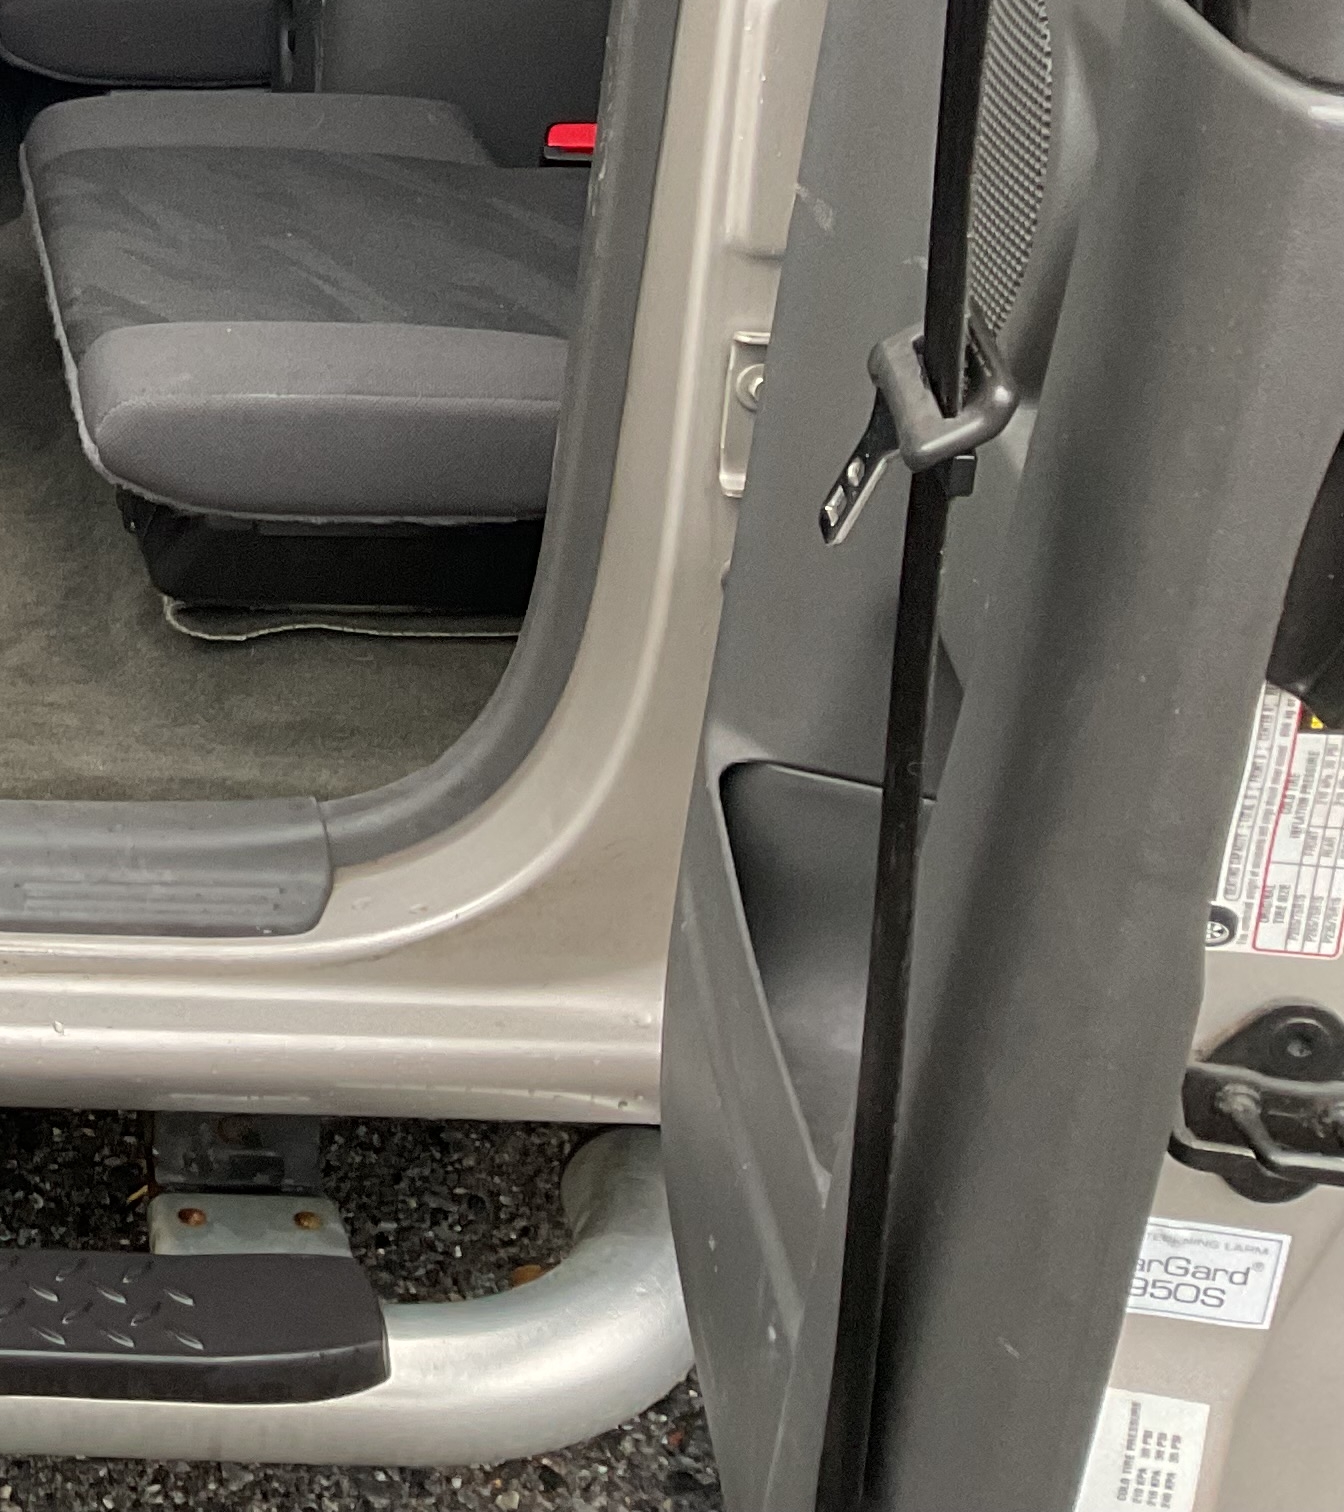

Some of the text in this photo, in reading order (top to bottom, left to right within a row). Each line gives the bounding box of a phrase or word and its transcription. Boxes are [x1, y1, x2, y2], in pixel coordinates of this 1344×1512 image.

[1224, 1242, 1269, 1257] LARM
[1117, 1400, 1141, 1501] COLD TIRE PRESSURE
